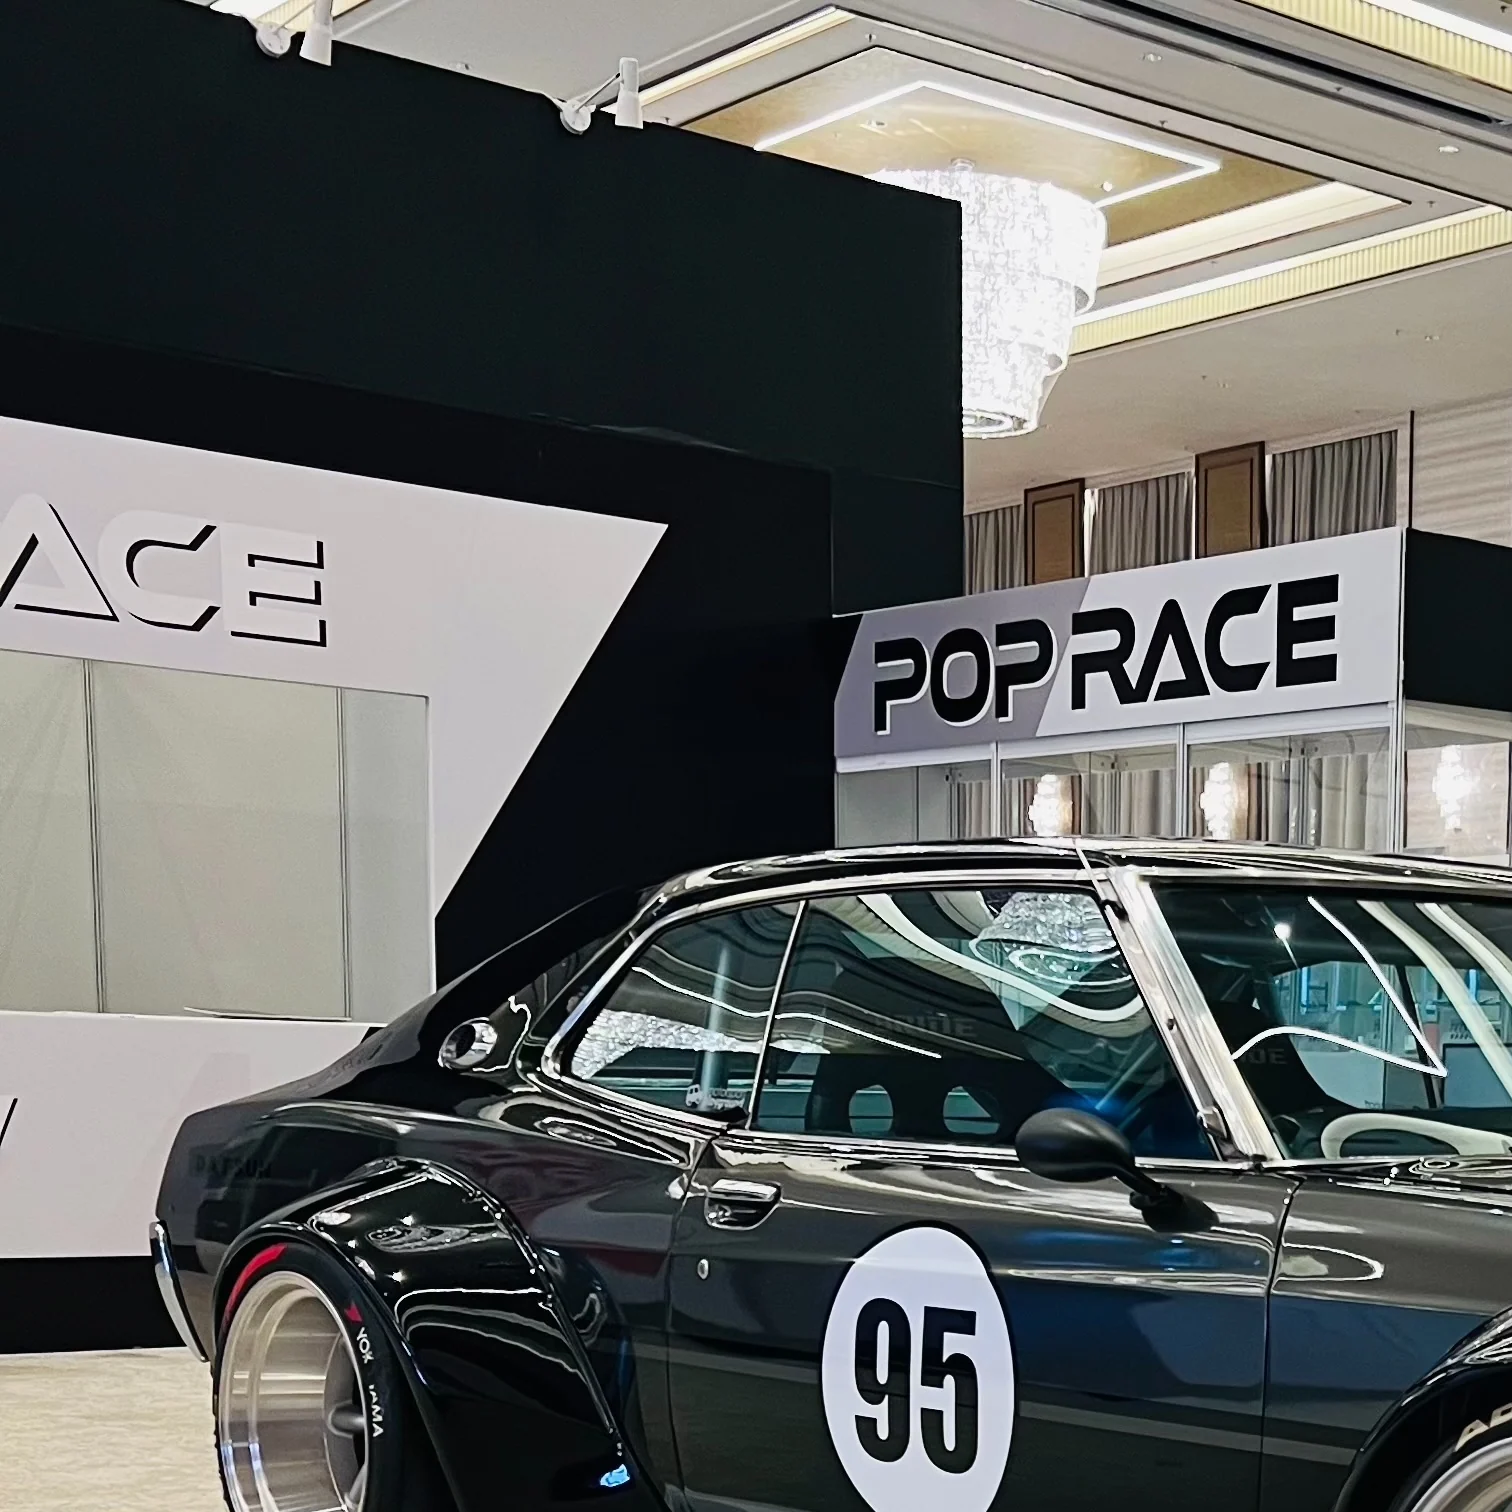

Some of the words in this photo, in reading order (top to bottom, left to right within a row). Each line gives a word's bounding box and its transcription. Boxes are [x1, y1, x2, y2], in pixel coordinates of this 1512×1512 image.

[873, 617, 1056, 735] POP
[1070, 573, 1340, 711] RACE
[854, 1297, 978, 1474] 95
